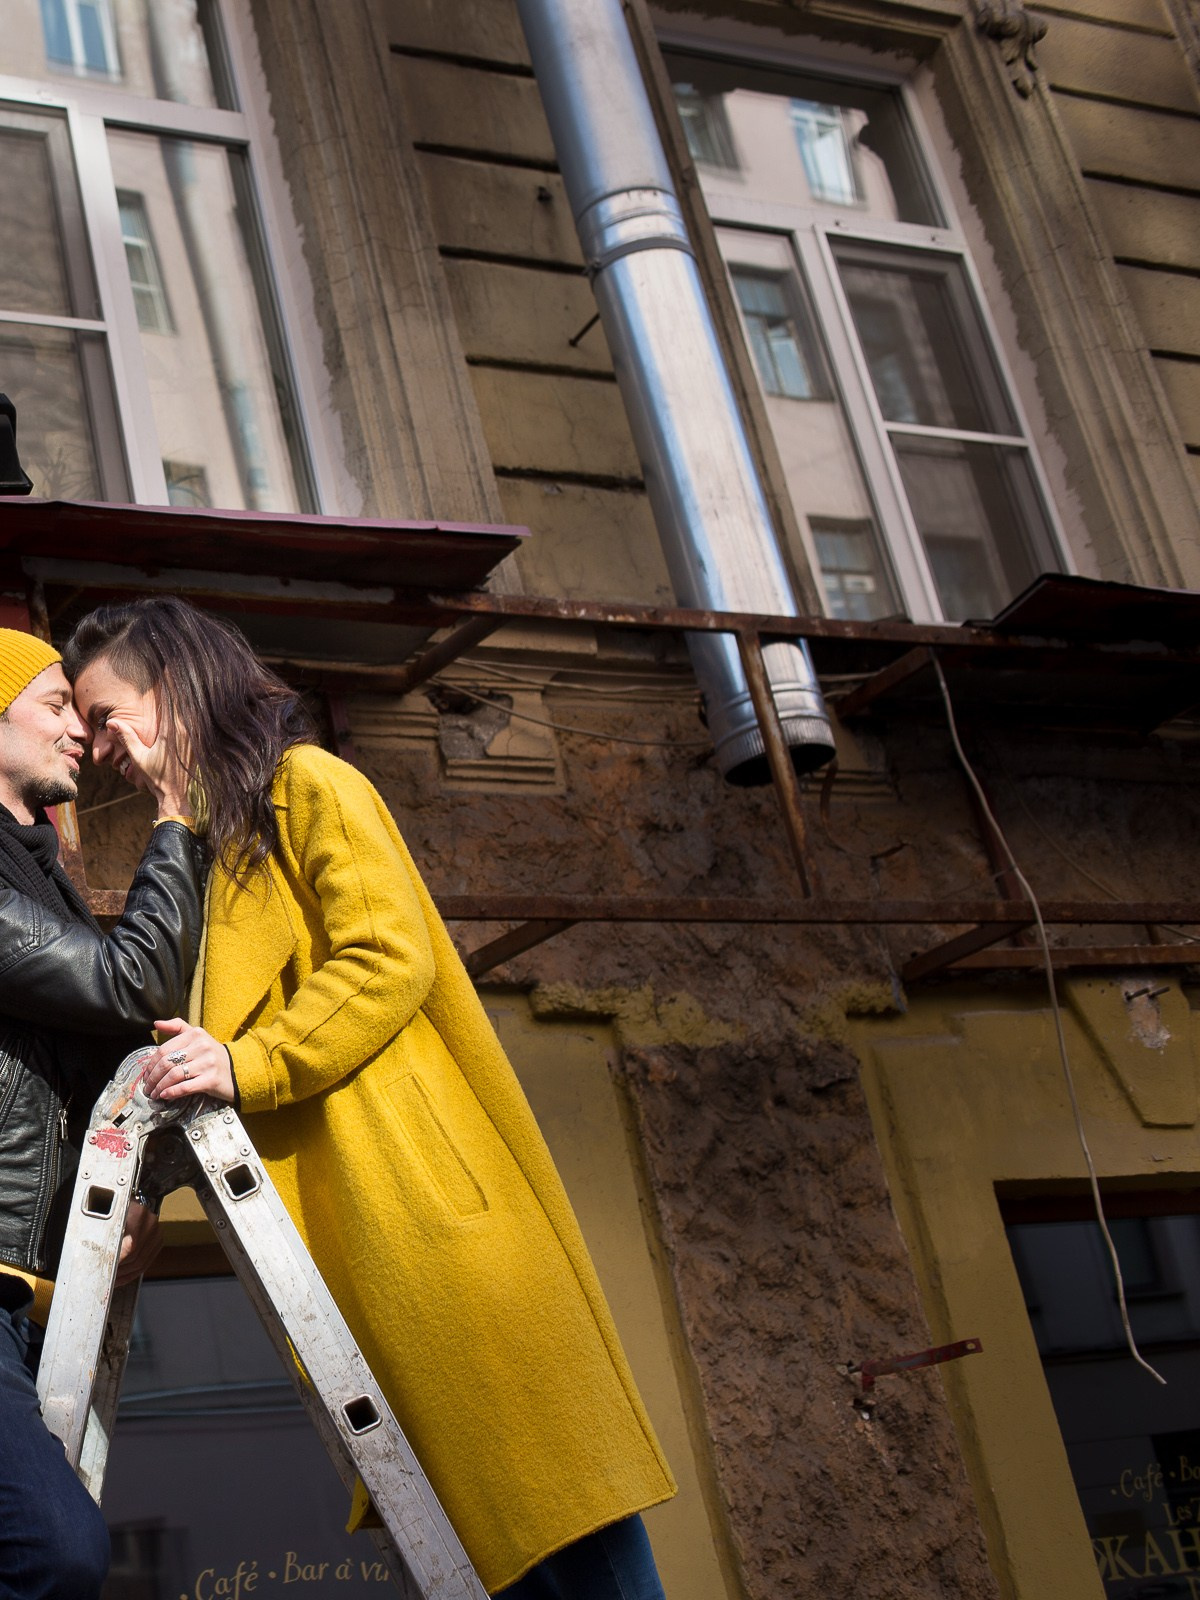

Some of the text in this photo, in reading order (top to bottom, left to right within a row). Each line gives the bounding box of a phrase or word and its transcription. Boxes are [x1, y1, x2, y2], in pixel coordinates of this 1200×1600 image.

[1120, 1462, 1164, 1502] Café
[194, 1560, 259, 1600] Café
[283, 1551, 330, 1584] Bar
[335, 1557, 354, 1581] à
